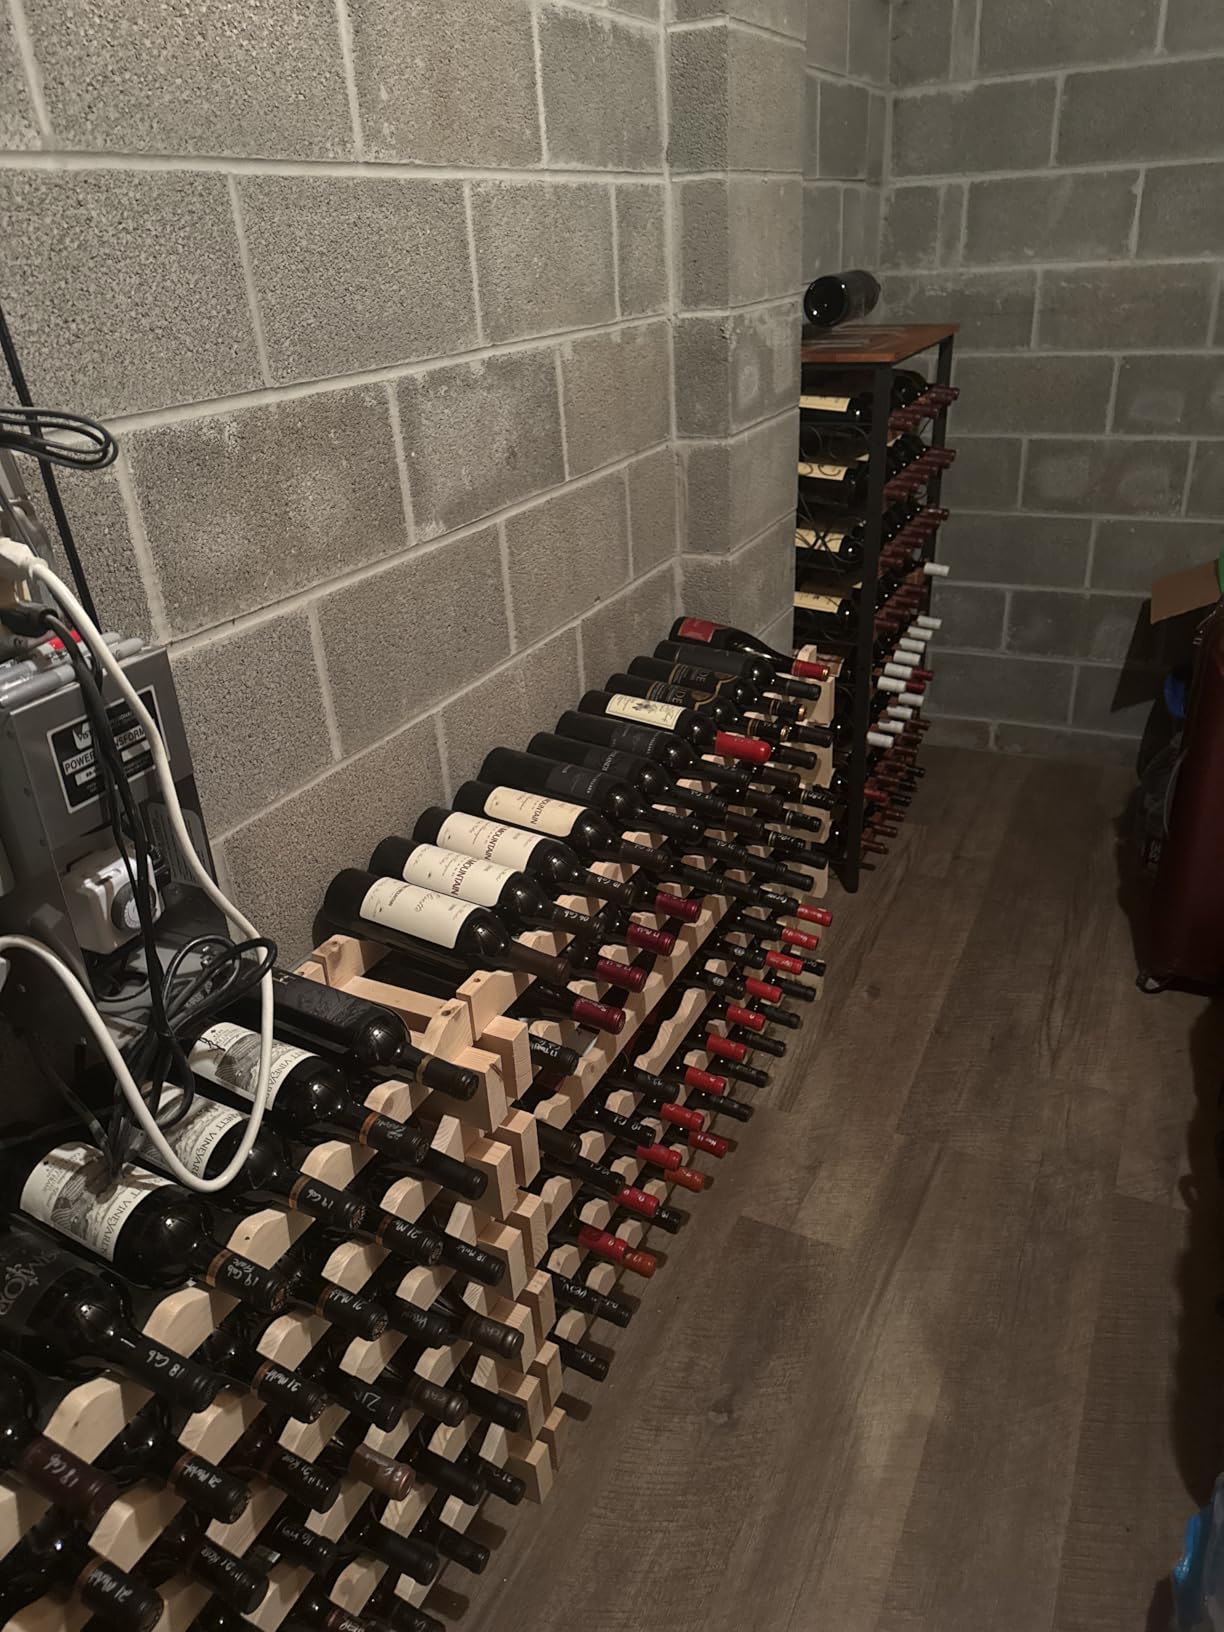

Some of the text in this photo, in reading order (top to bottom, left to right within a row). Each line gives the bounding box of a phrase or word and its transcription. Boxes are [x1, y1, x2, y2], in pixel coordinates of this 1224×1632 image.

[64, 751, 96, 773] POWER
[450, 859, 477, 896] MOUNTAIN
[226, 1264, 260, 1287] 19 Cab
[146, 1350, 185, 1378] 18 Cab
[114, 1585, 134, 1602] 21
